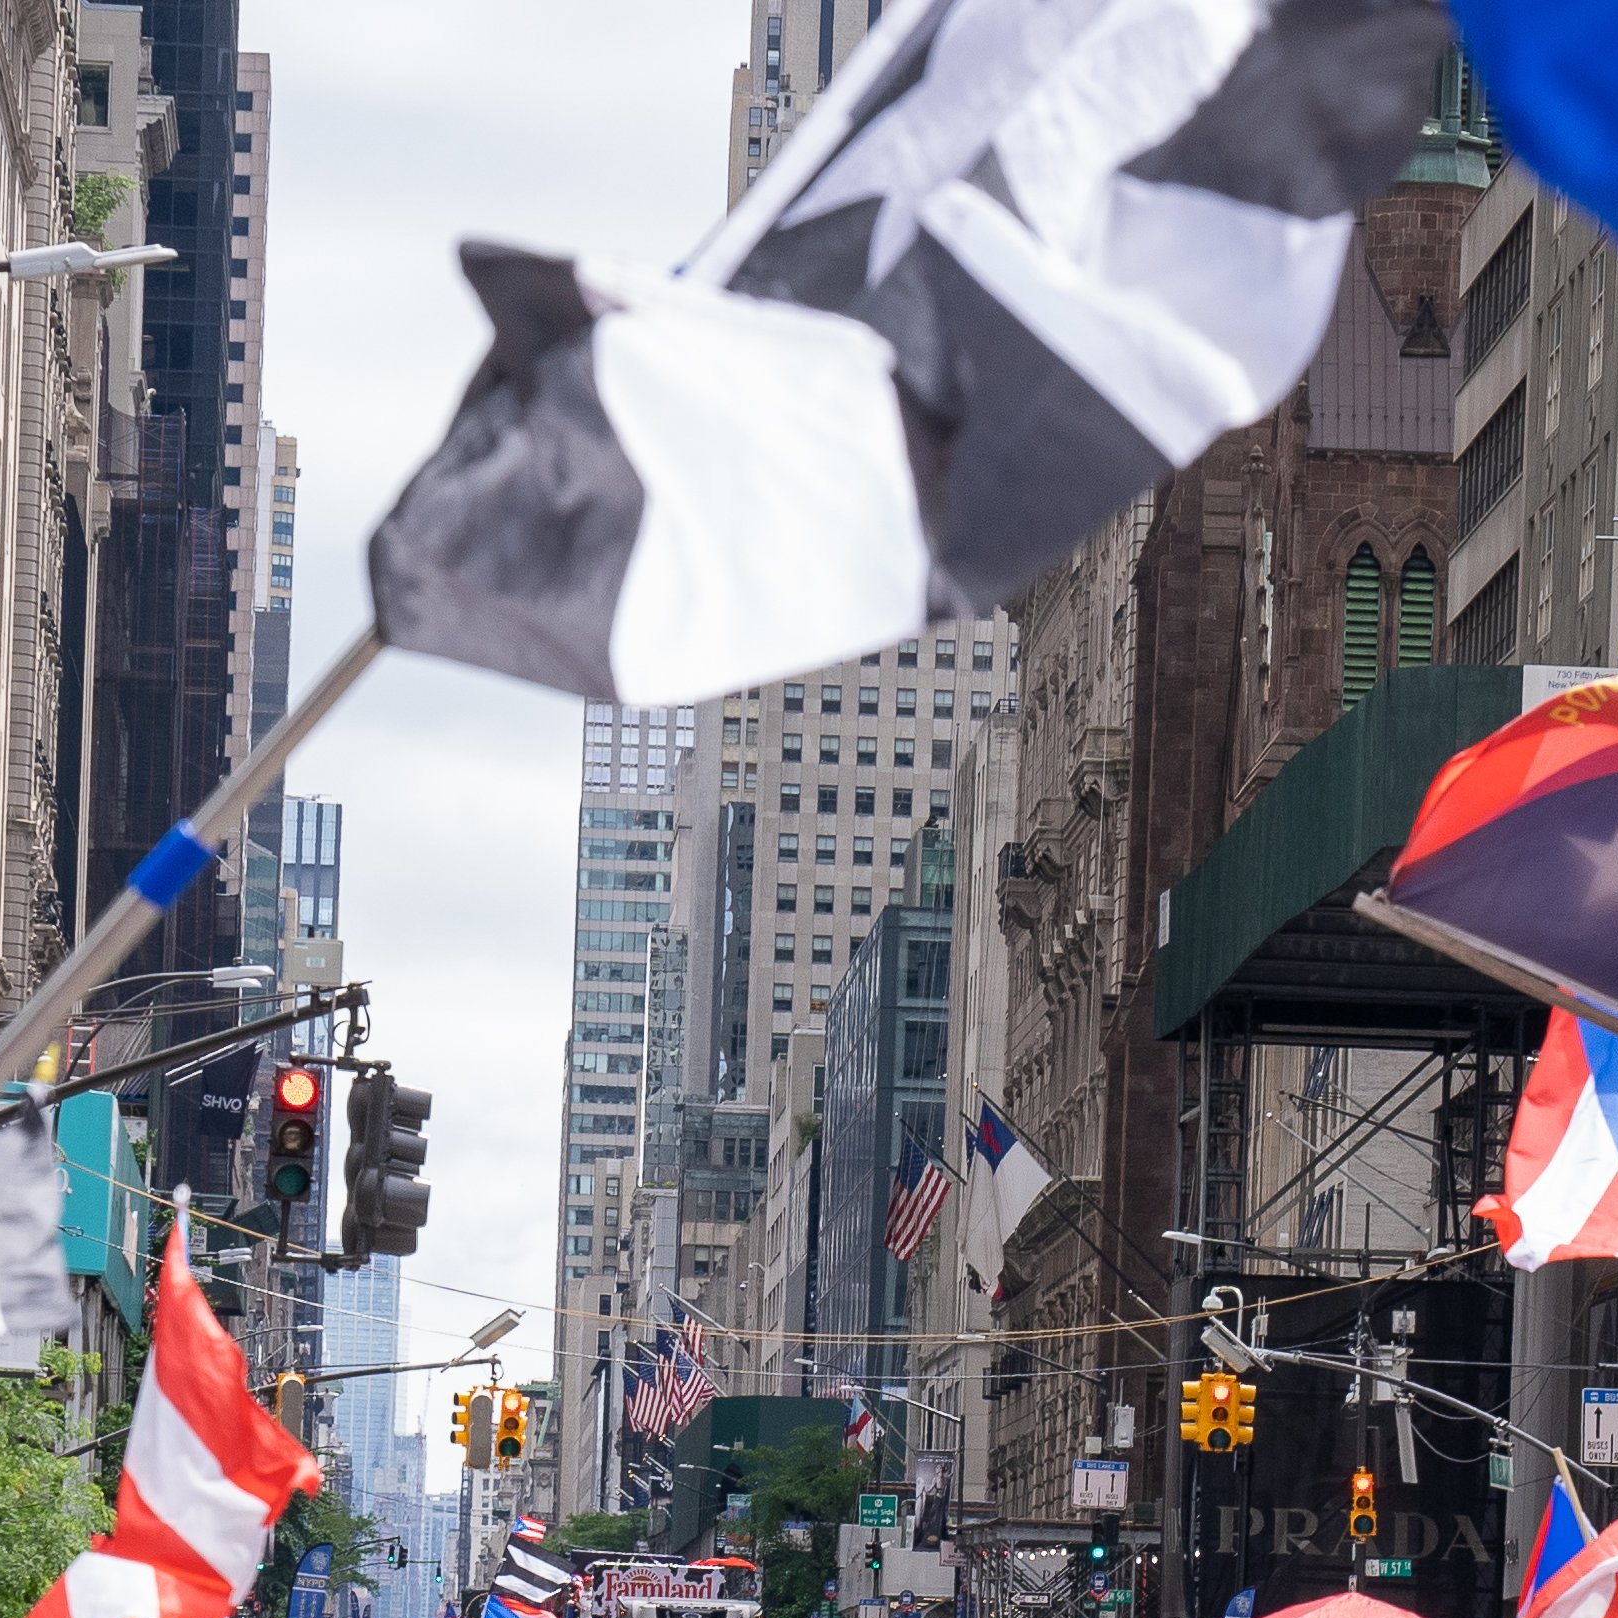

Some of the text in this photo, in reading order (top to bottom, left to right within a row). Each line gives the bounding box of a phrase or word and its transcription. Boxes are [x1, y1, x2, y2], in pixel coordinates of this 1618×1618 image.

[1556, 669, 1572, 680] 730
[202, 1094, 242, 1111] SHVO
[1587, 1440, 1609, 1450] BUSES
[1588, 1450, 1607, 1461] ONLY
[1215, 1504, 1493, 1563] PRADA
[297, 1577, 326, 1589] NYPD
[605, 1572, 713, 1601] Farmland
